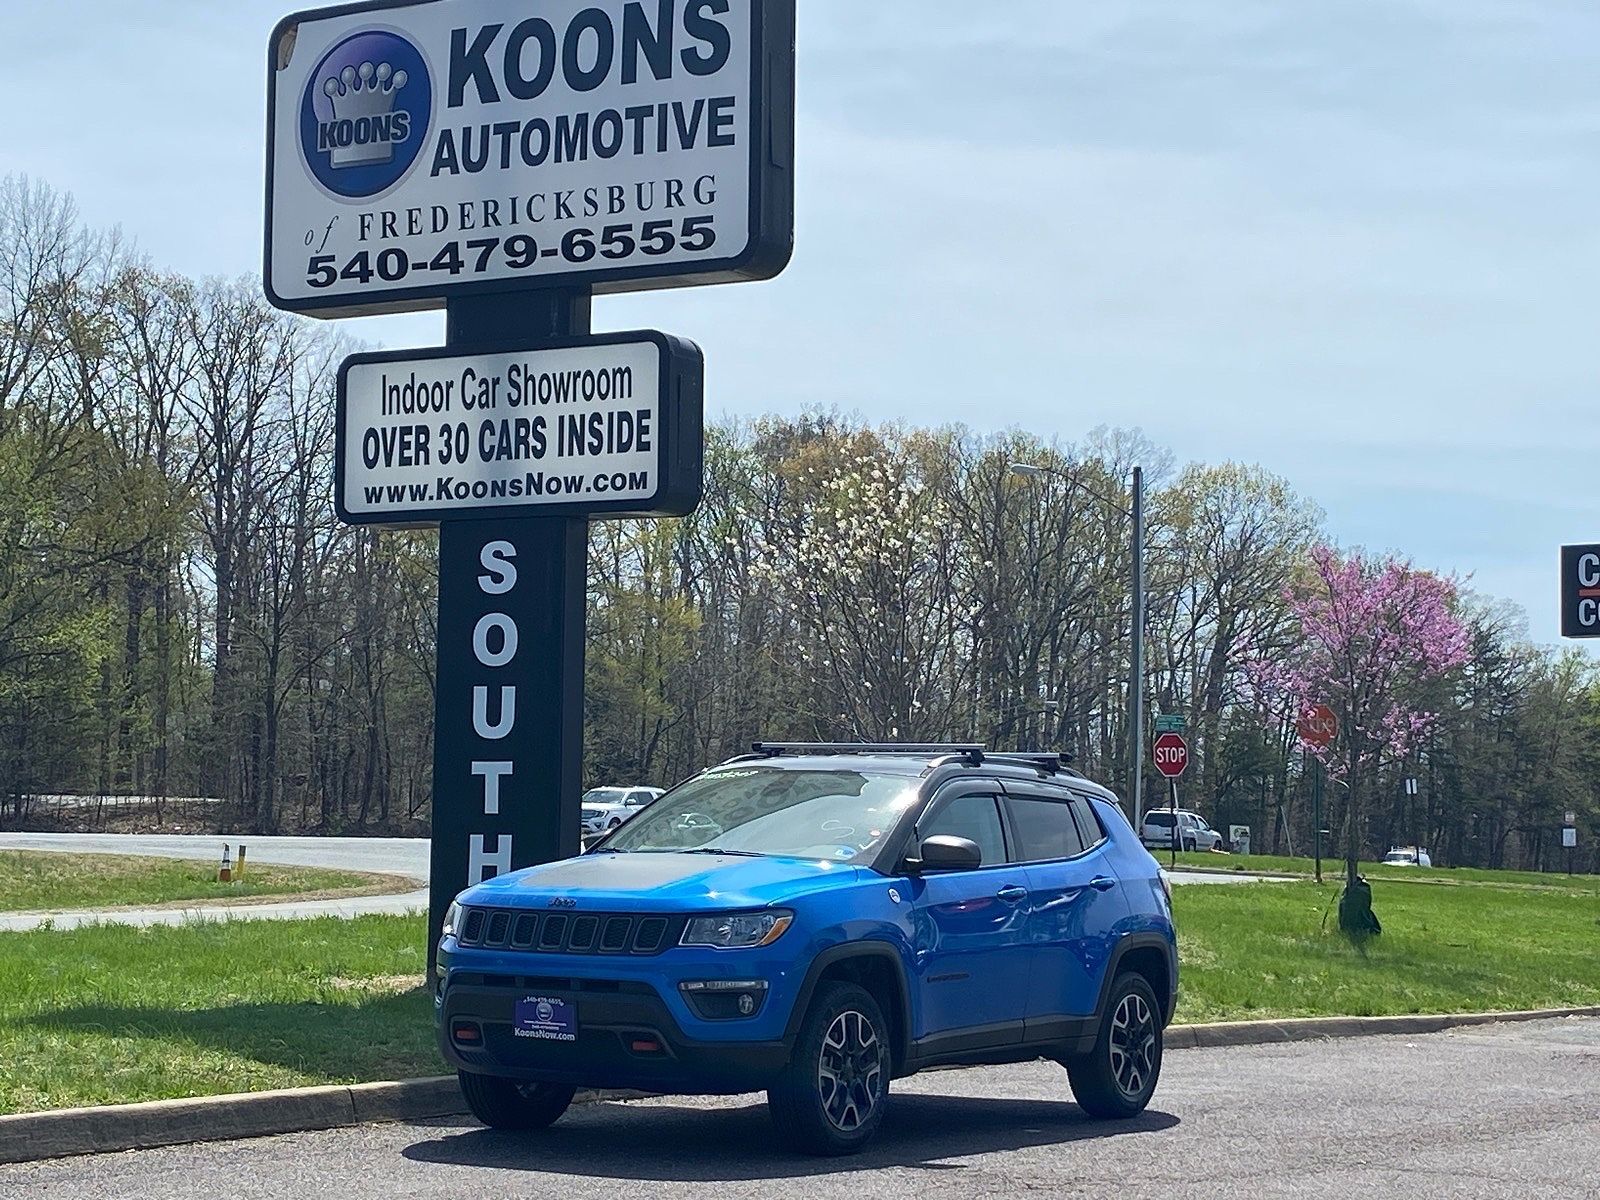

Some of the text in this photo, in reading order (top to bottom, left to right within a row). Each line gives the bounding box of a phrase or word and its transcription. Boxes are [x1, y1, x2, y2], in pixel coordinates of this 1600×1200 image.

[446, 0, 732, 108] KOONS
[317, 109, 412, 151] KOONS
[430, 96, 736, 178] AUTOMOTIVE
[303, 174, 718, 254] of FREDERICKSBURG
[306, 214, 717, 289] 540-479-6555
[381, 363, 633, 416] Indoor Car Showroom
[362, 409, 651, 470] OVER 30 CARS INSIDE
[467, 540, 518, 887] SOUTH
[1156, 747, 1186, 764] STOP
[514, 1027, 576, 1041] KoonsNow.com
